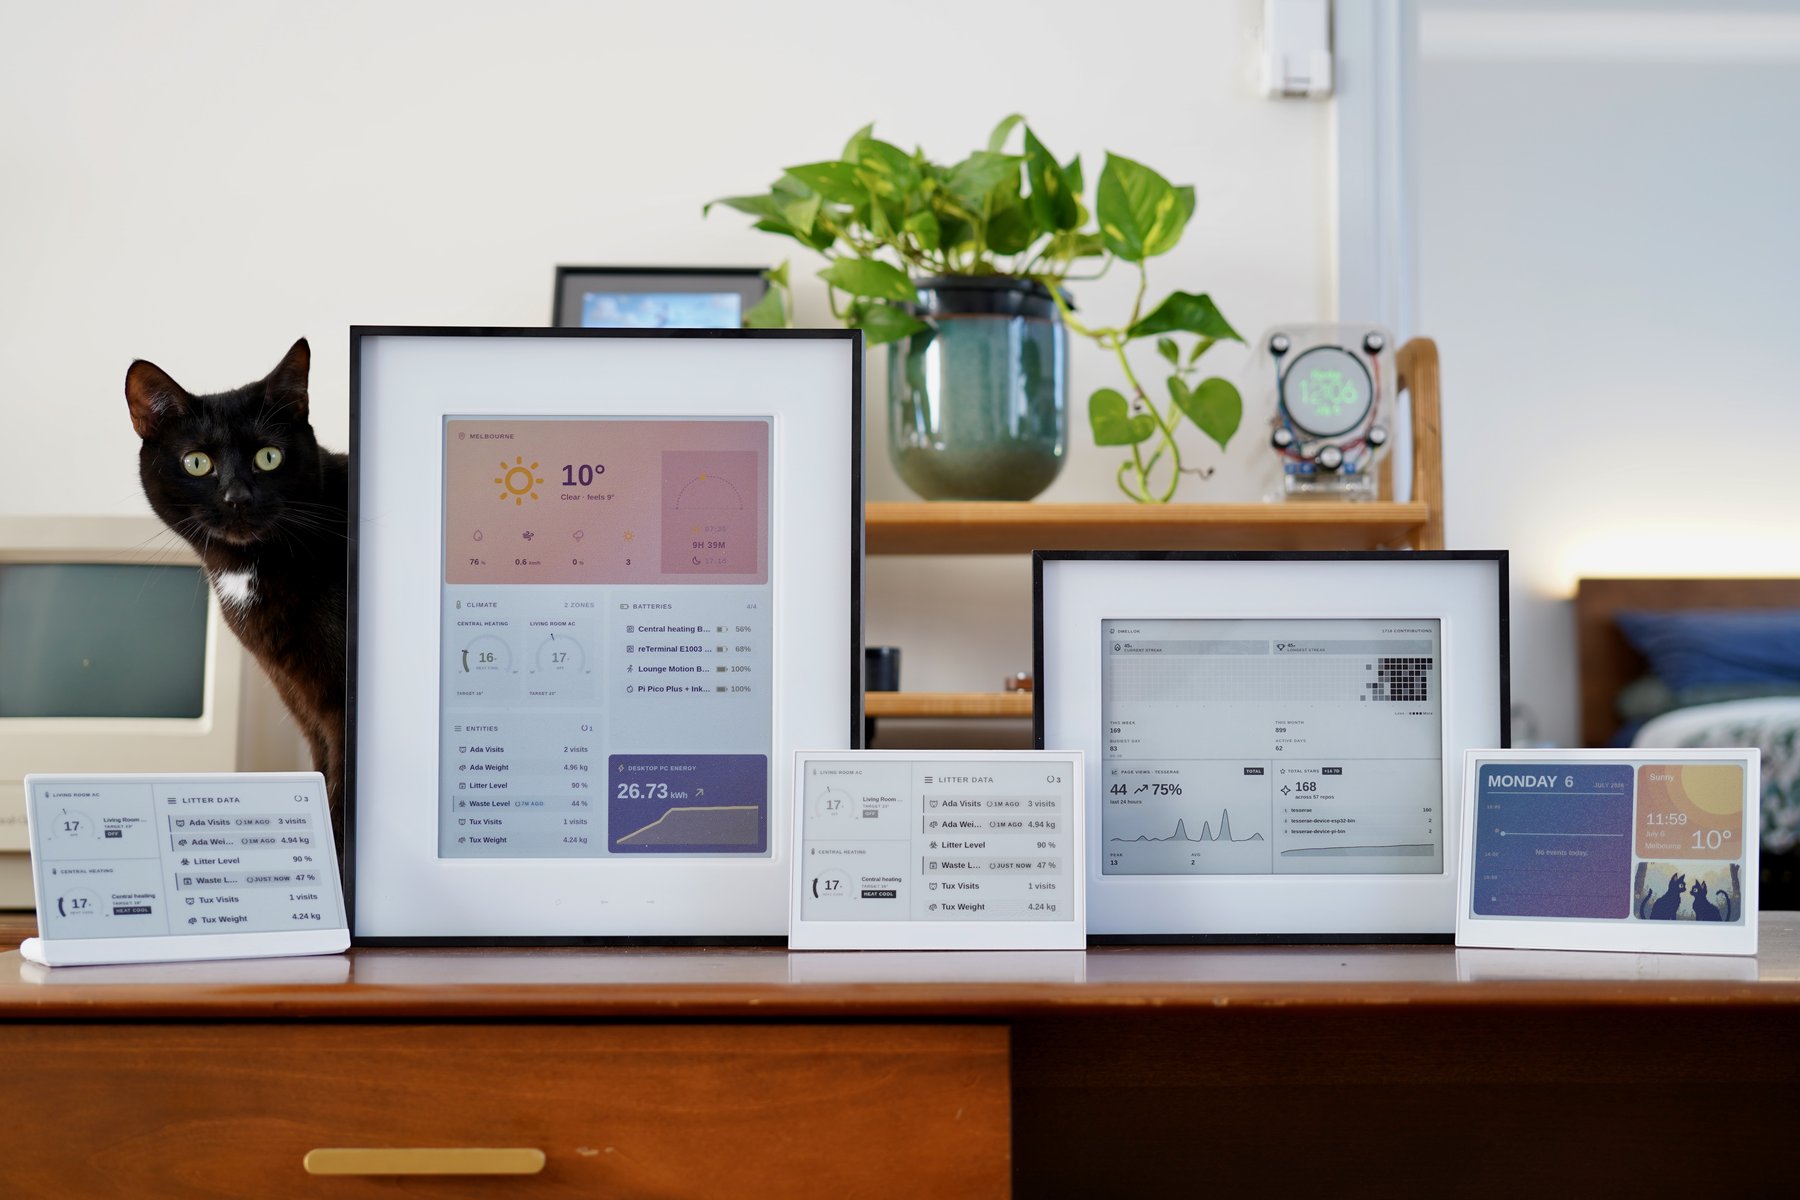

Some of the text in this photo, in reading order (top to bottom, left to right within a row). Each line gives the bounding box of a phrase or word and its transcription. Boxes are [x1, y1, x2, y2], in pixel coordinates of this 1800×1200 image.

[562, 464, 605, 486] 10°
[667, 626, 696, 634] heating
[638, 666, 667, 674] Lounge
[485, 764, 509, 772] Weight
[579, 764, 588, 772] kg
[1488, 776, 1574, 788] MONDAY 6
[1649, 773, 1674, 782] Sunny
[617, 783, 668, 799] 26.73
[1110, 783, 1182, 795] 44 75%
[1295, 782, 1317, 792] 168
[1647, 813, 1687, 825] 11:59
[1046, 821, 1055, 829] kg
[1692, 830, 1731, 849] 10°
[958, 903, 985, 912] Weight
[1046, 903, 1056, 912] kg
[219, 915, 247, 924] Weight
[310, 913, 321, 921] kg
